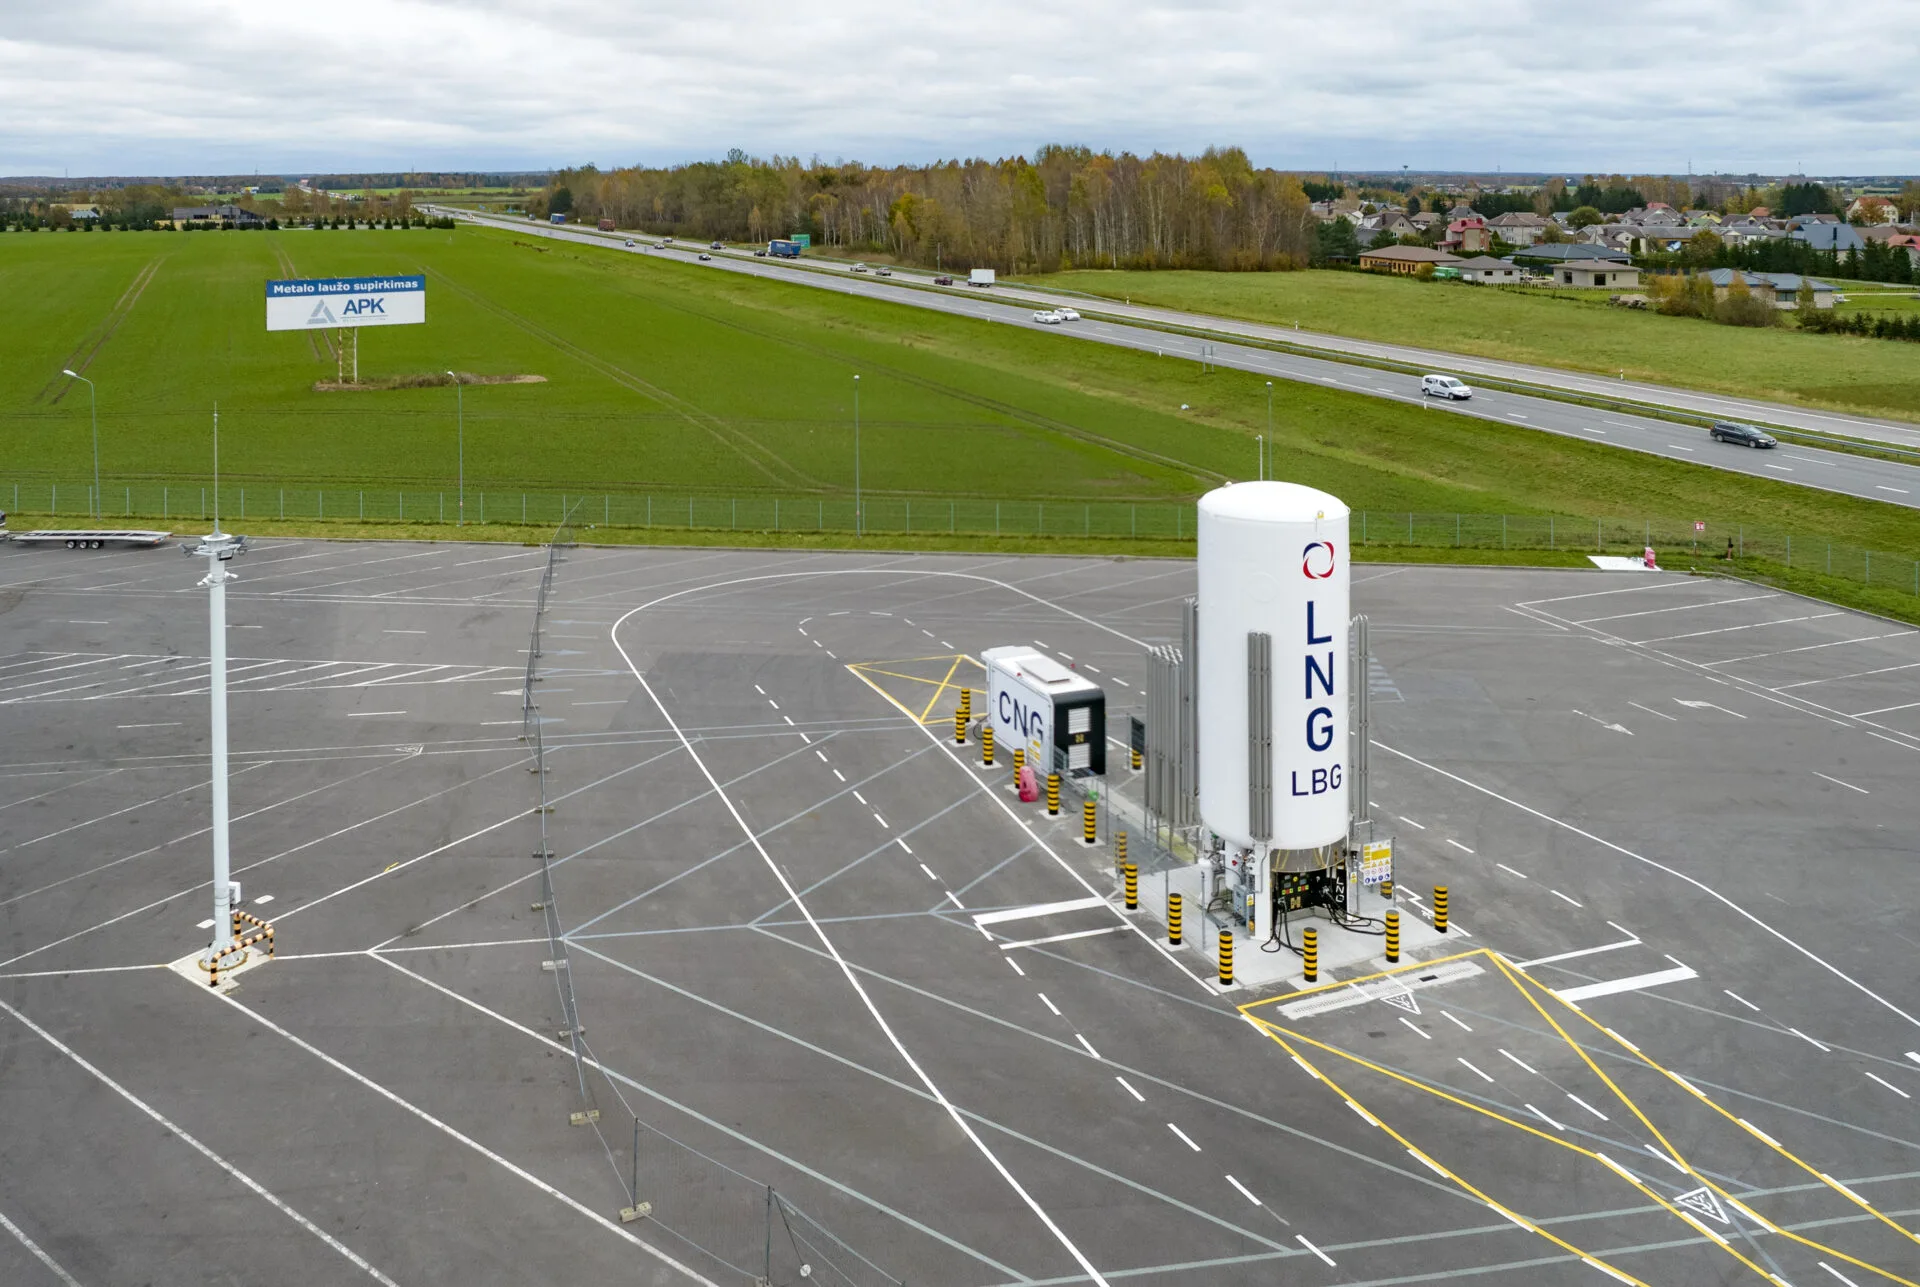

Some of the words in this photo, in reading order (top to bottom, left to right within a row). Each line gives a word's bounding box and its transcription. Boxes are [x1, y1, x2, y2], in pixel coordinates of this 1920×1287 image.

[273, 284, 315, 294] Metalo
[318, 281, 351, 292] laužo
[353, 280, 418, 291] supirkimas
[343, 297, 385, 315] APK
[1305, 600, 1334, 752] LNG
[998, 690, 1044, 743] CNG
[1291, 763, 1342, 797] LBG
